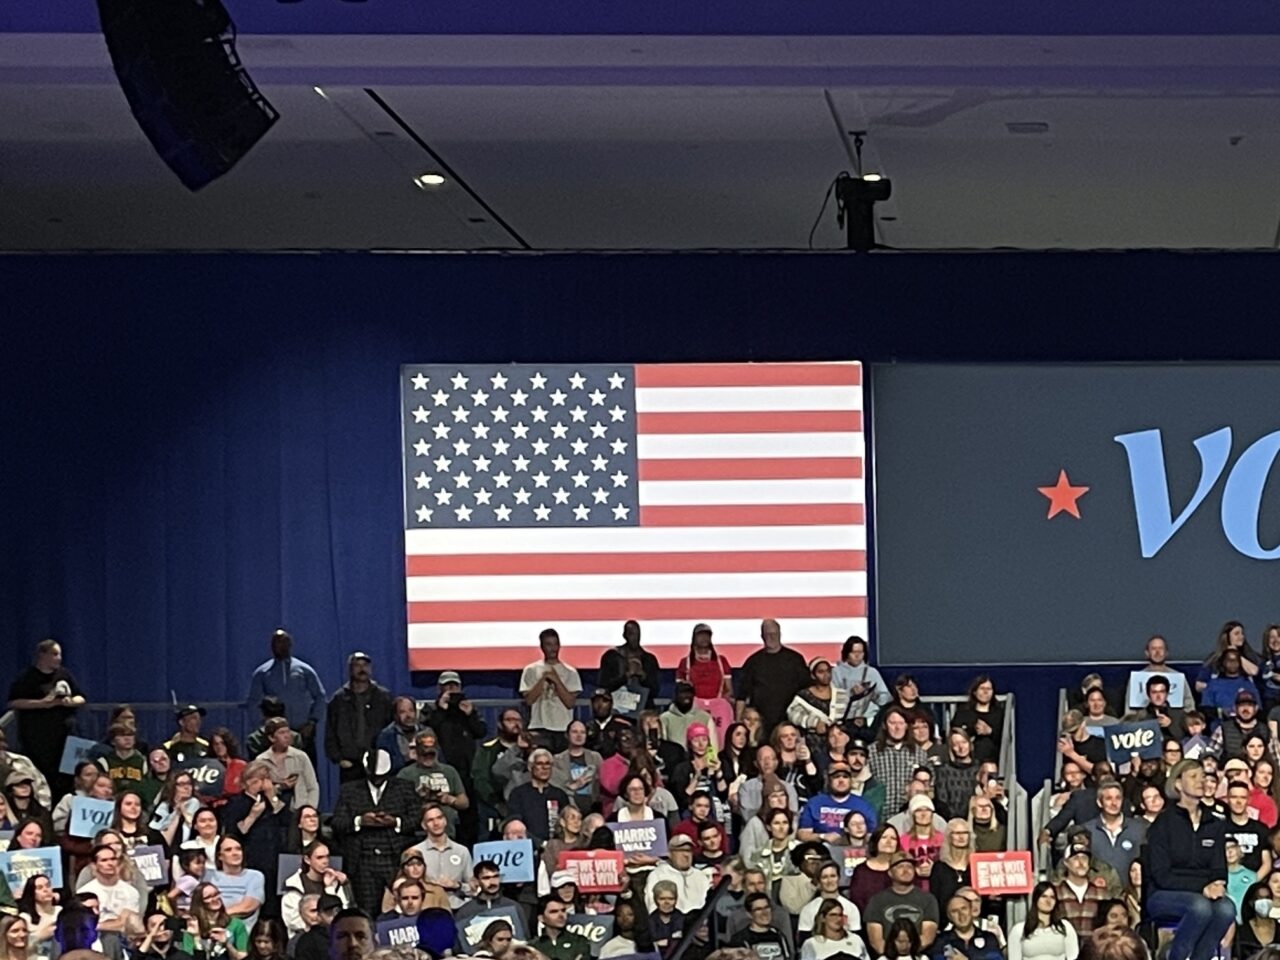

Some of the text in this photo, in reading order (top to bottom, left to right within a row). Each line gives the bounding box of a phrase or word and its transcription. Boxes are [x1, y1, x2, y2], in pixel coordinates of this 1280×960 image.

[1111, 728, 1154, 750] vote
[188, 765, 219, 784] ote
[614, 827, 657, 844] HARRIS
[622, 842, 652, 851] WALZ
[579, 859, 593, 873] WE
[594, 859, 618, 872] VOTE
